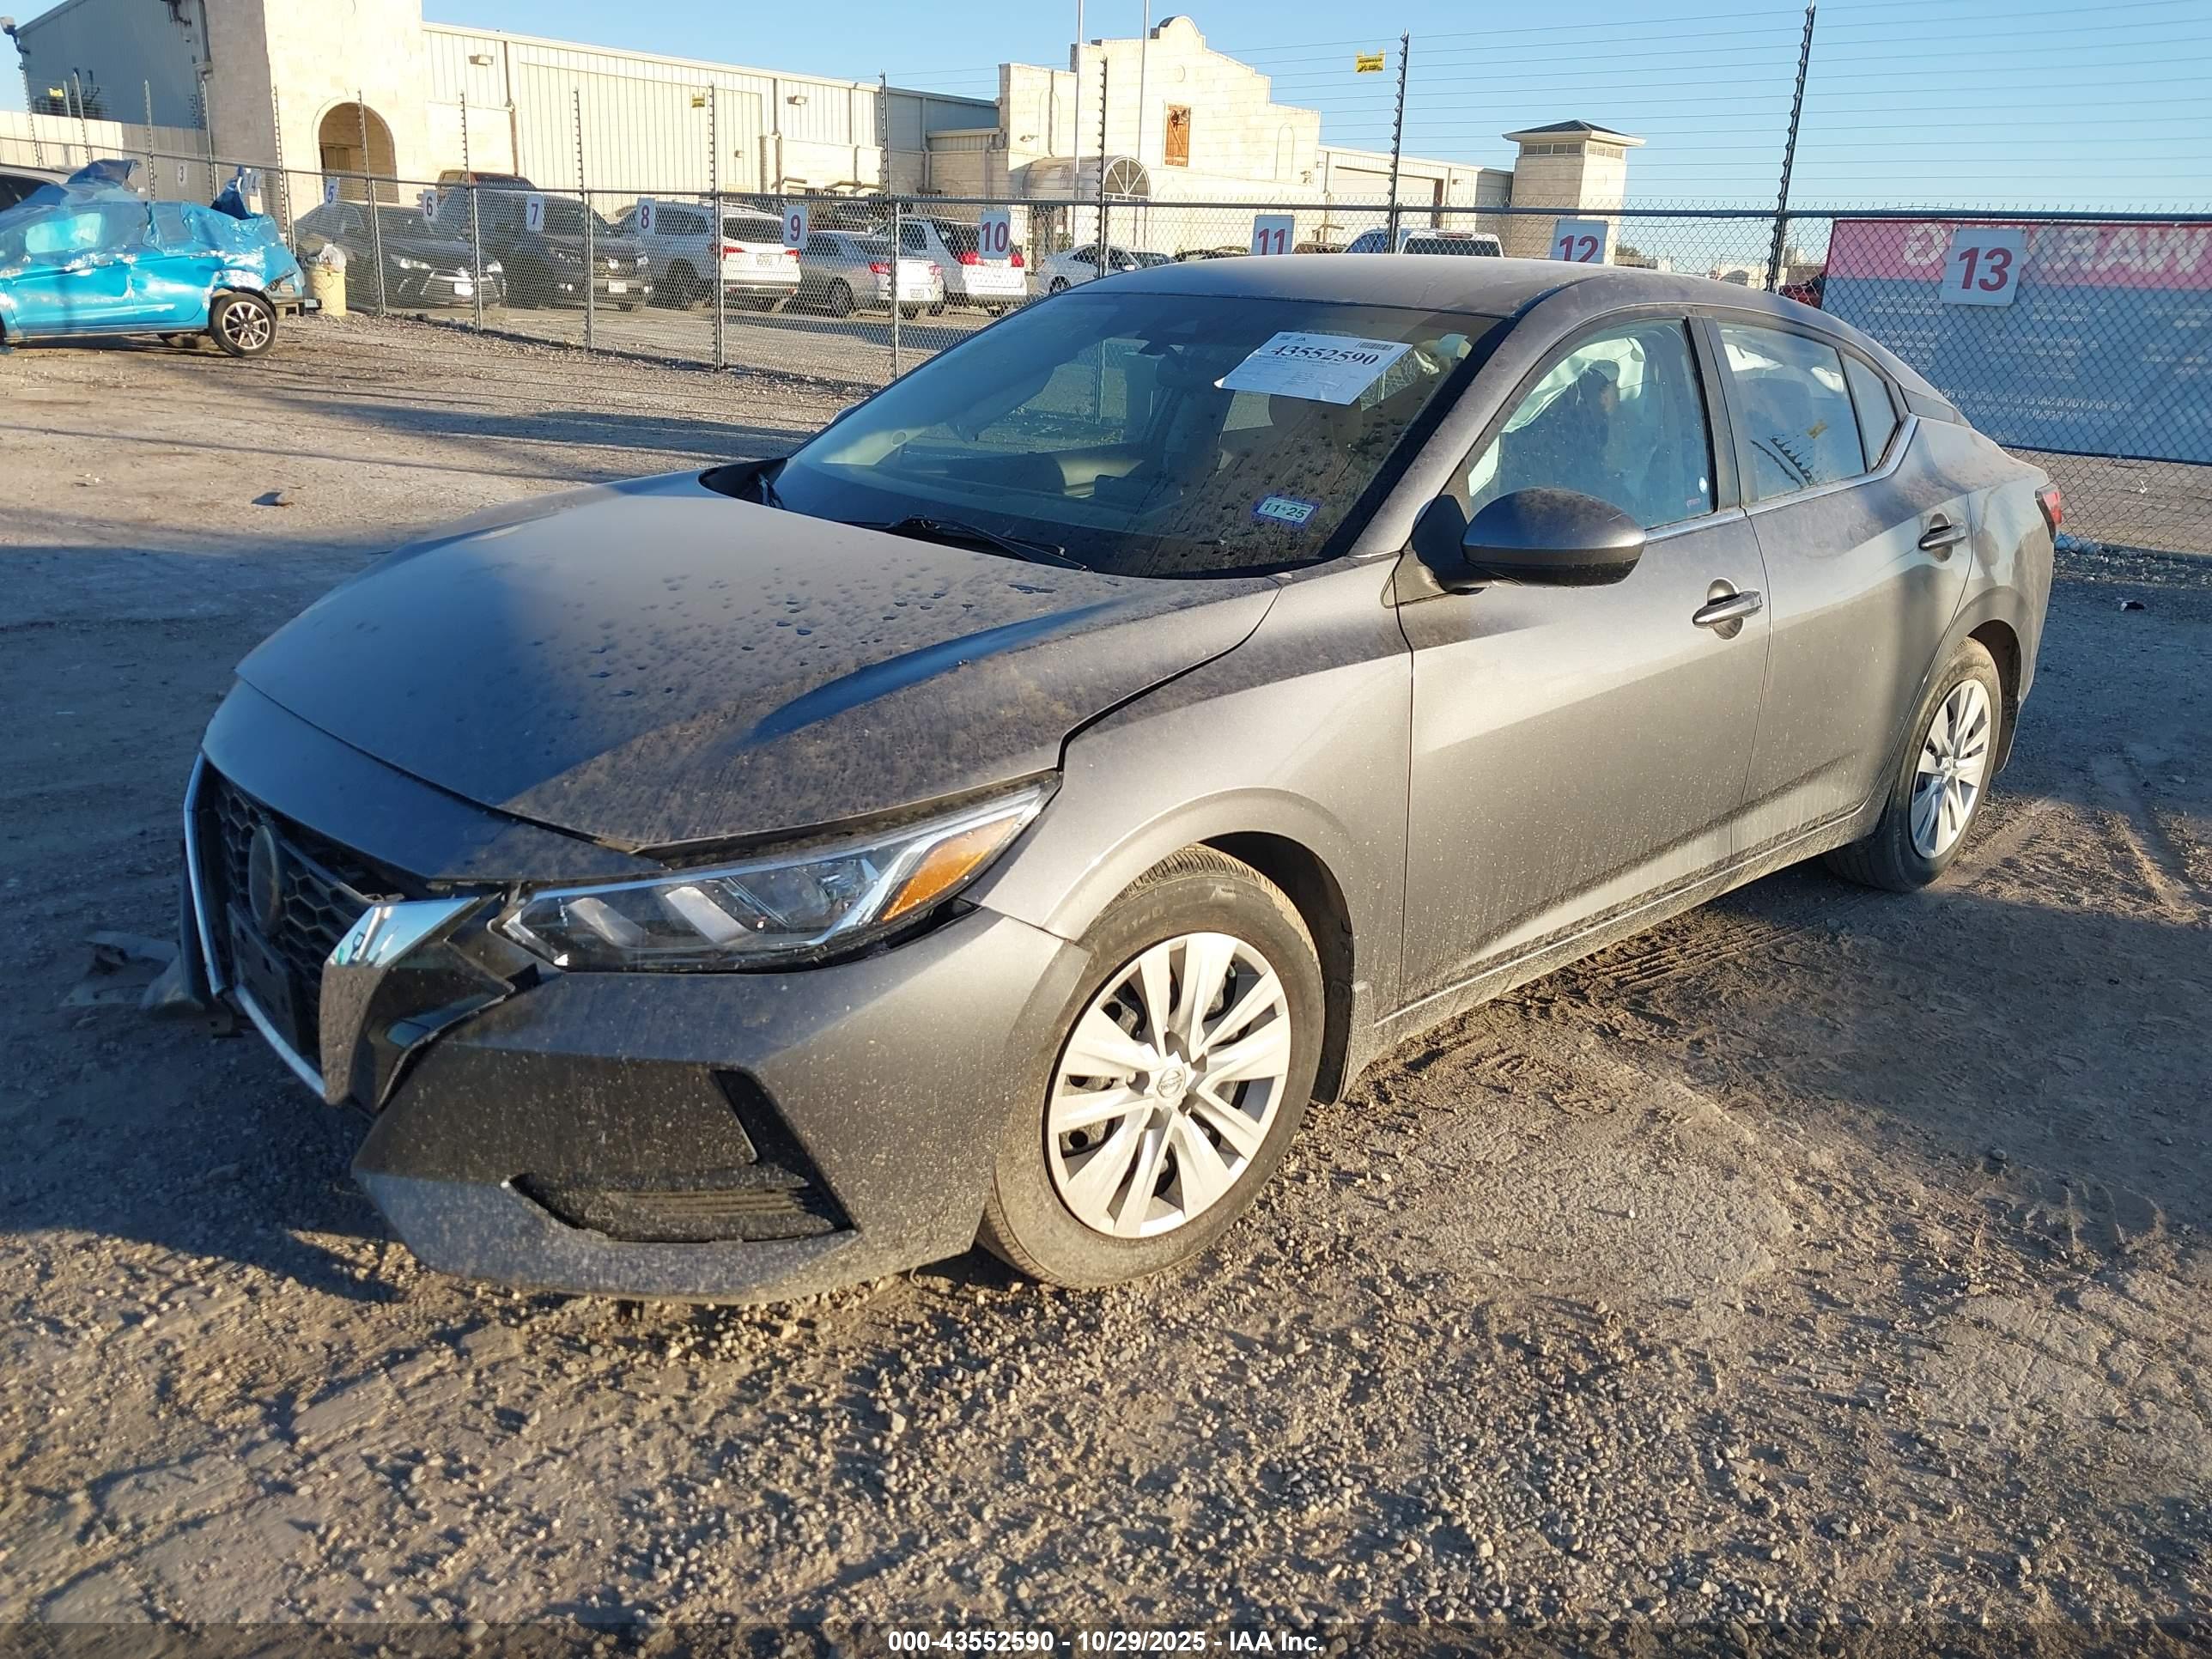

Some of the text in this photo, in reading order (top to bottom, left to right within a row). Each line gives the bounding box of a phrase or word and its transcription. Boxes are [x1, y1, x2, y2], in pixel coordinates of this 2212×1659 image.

[178, 165, 184, 183] 3
[327, 191, 334, 204] 5
[426, 196, 433, 216] 6
[531, 203, 538, 225] 7
[641, 204, 649, 229] 8
[790, 215, 801, 241] 9
[981, 221, 1008, 252] 10
[1258, 228, 1285, 255] 11
[1559, 234, 1599, 262] 12
[1958, 246, 2013, 292] 13
[1271, 344, 1379, 366] 43552590
